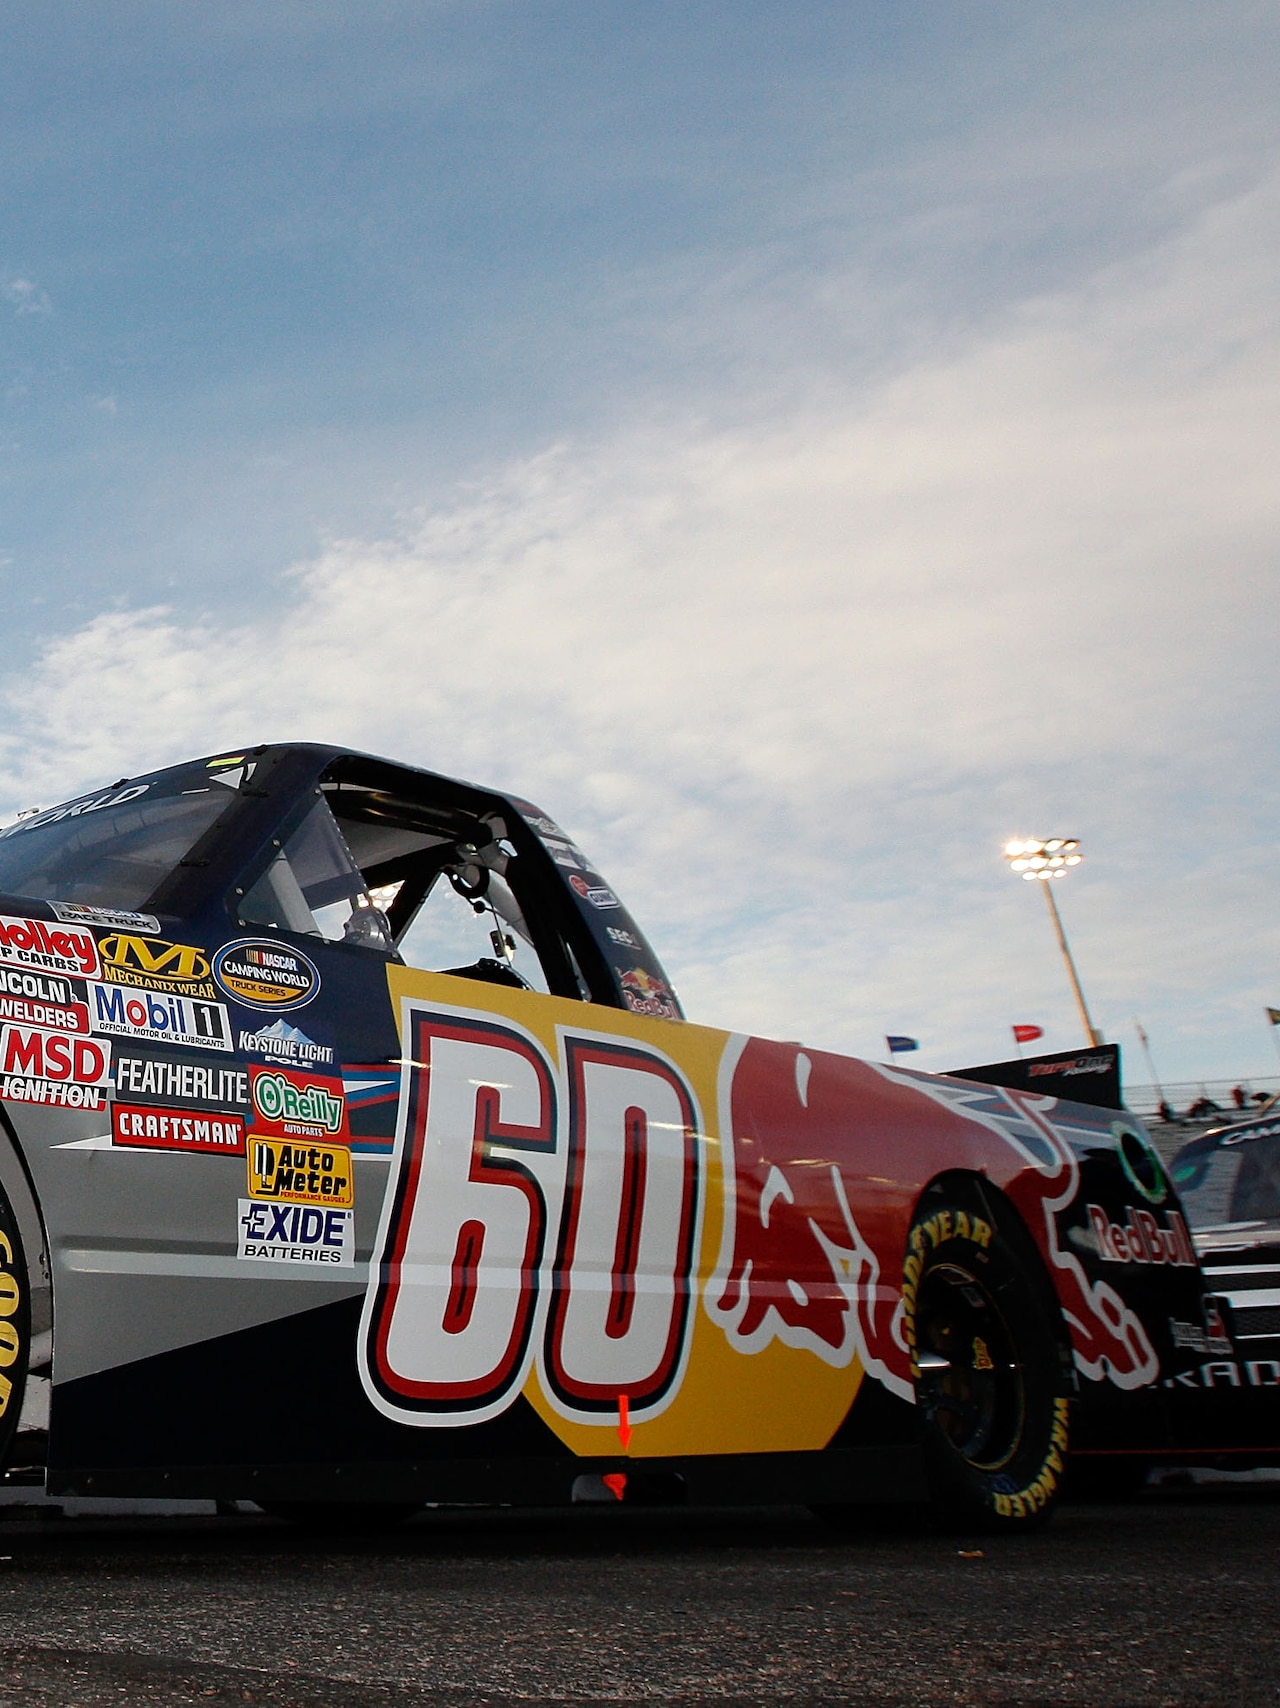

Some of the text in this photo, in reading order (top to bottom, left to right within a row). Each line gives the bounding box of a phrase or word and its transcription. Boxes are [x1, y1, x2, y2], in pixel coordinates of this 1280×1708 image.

[60, 911, 153, 930] RACE TRUCK
[19, 949, 80, 973] CARBS
[224, 961, 310, 988] CAMPING WORLD
[262, 951, 298, 972] NASCAR
[103, 964, 217, 1000] MECHANIX WEAR
[230, 979, 287, 997] TRUCK SERIES
[95, 985, 214, 1037] Mobil 1
[623, 988, 681, 1020] Red Bull
[99, 1022, 132, 1035] OFFICIAL
[133, 1027, 160, 1039] MOTOR
[161, 1031, 173, 1040] OIL
[181, 1034, 226, 1048] LUBRICANTS
[239, 1030, 333, 1064] KEYSTONE LIGHT
[4, 1029, 105, 1084] MSD
[264, 1055, 314, 1069] POLE
[2, 1076, 100, 1109] IGNITION
[119, 1057, 249, 1103] FEATHERLITE
[258, 1078, 340, 1128] O'Reilly
[119, 1112, 239, 1146] CRAFTSMAN
[283, 1123, 324, 1138] AUTO PARTS
[278, 1145, 334, 1172] Auto
[274, 1167, 347, 1196] Meter
[242, 1203, 347, 1248] EXIDE
[357, 996, 706, 1428] 60
[1086, 1203, 1198, 1268] Red Bull
[244, 1244, 342, 1263] BATTERIES
